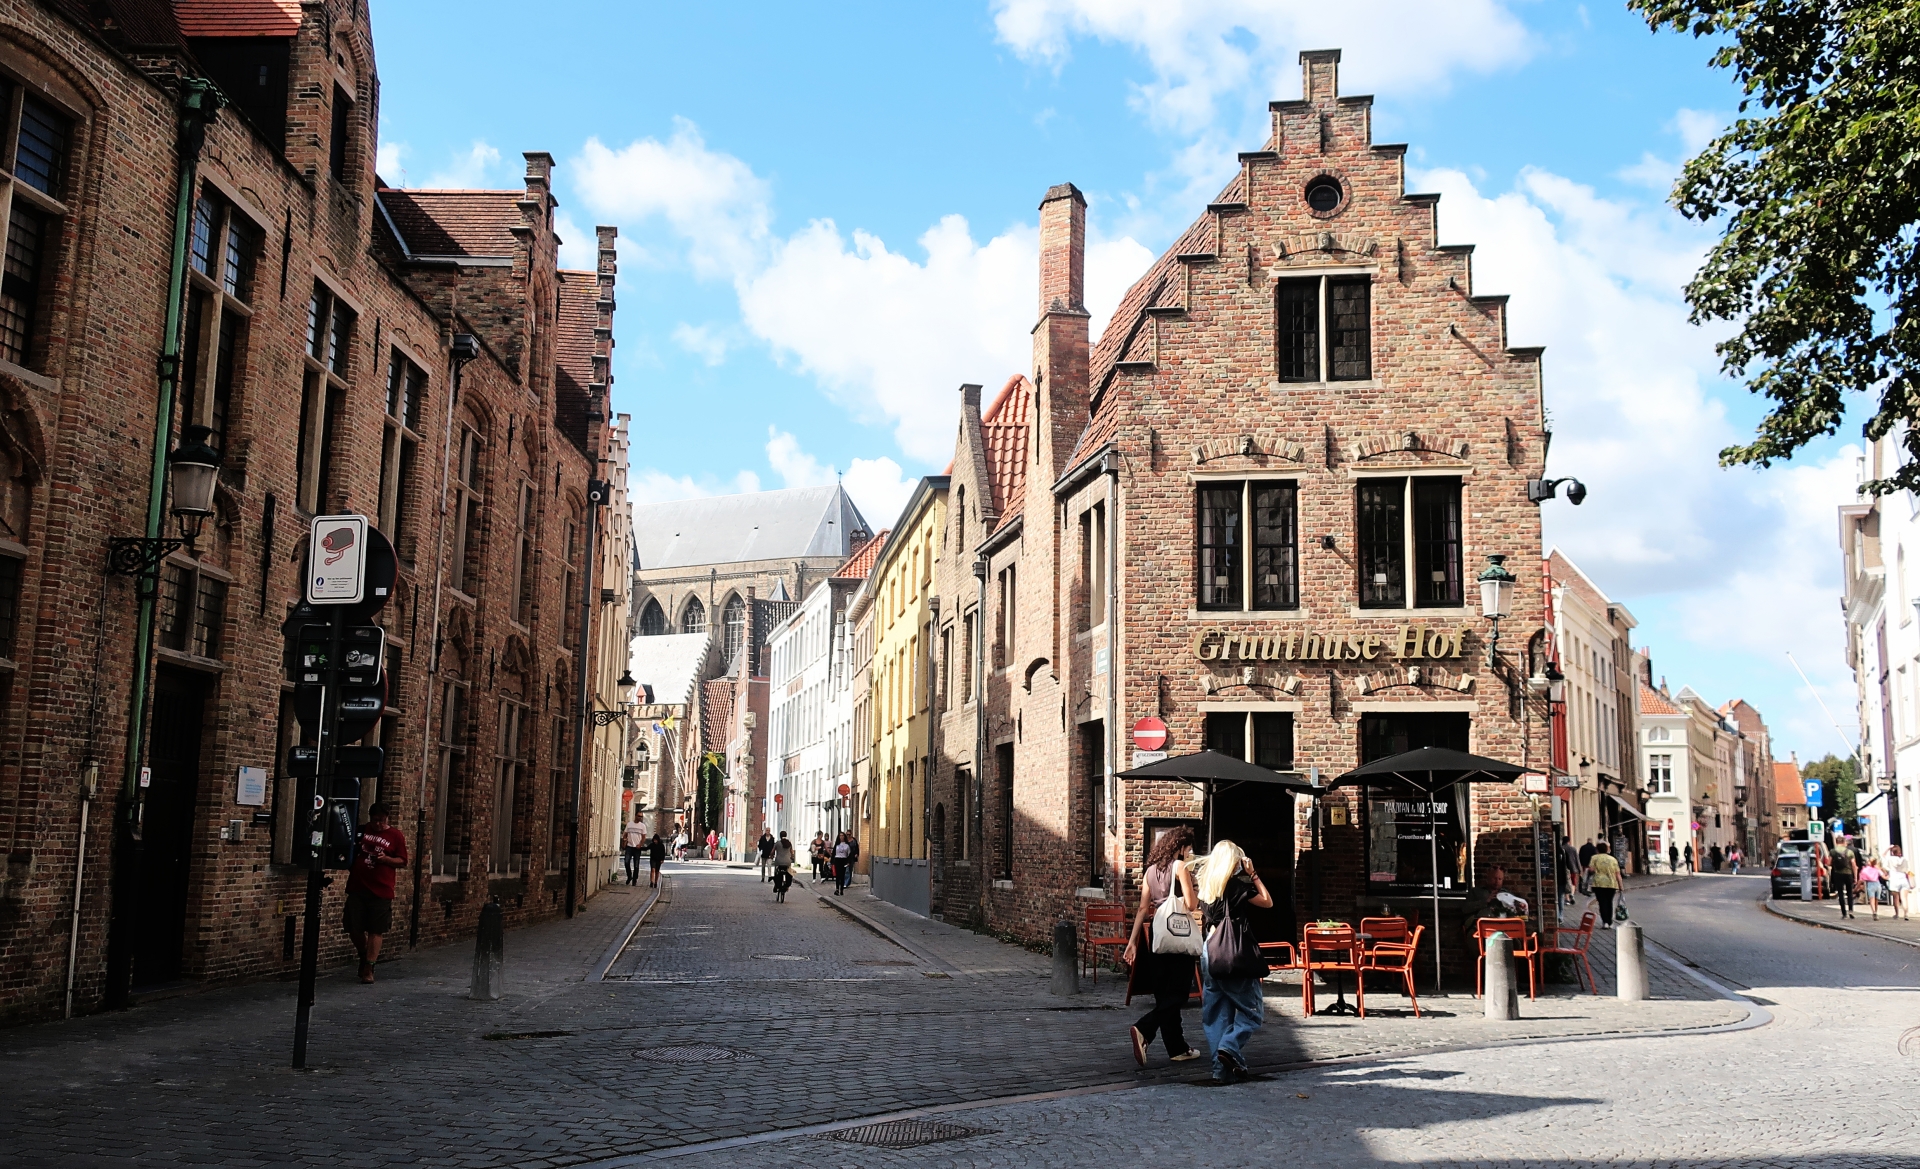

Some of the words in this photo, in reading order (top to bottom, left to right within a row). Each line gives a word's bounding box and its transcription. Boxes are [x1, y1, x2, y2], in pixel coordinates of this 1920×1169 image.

[1193, 626, 1380, 660] Gruuthuse
[1393, 622, 1469, 659] Hof
[1806, 782, 1819, 797] P
[1384, 802, 1410, 814] MARZIPAN
